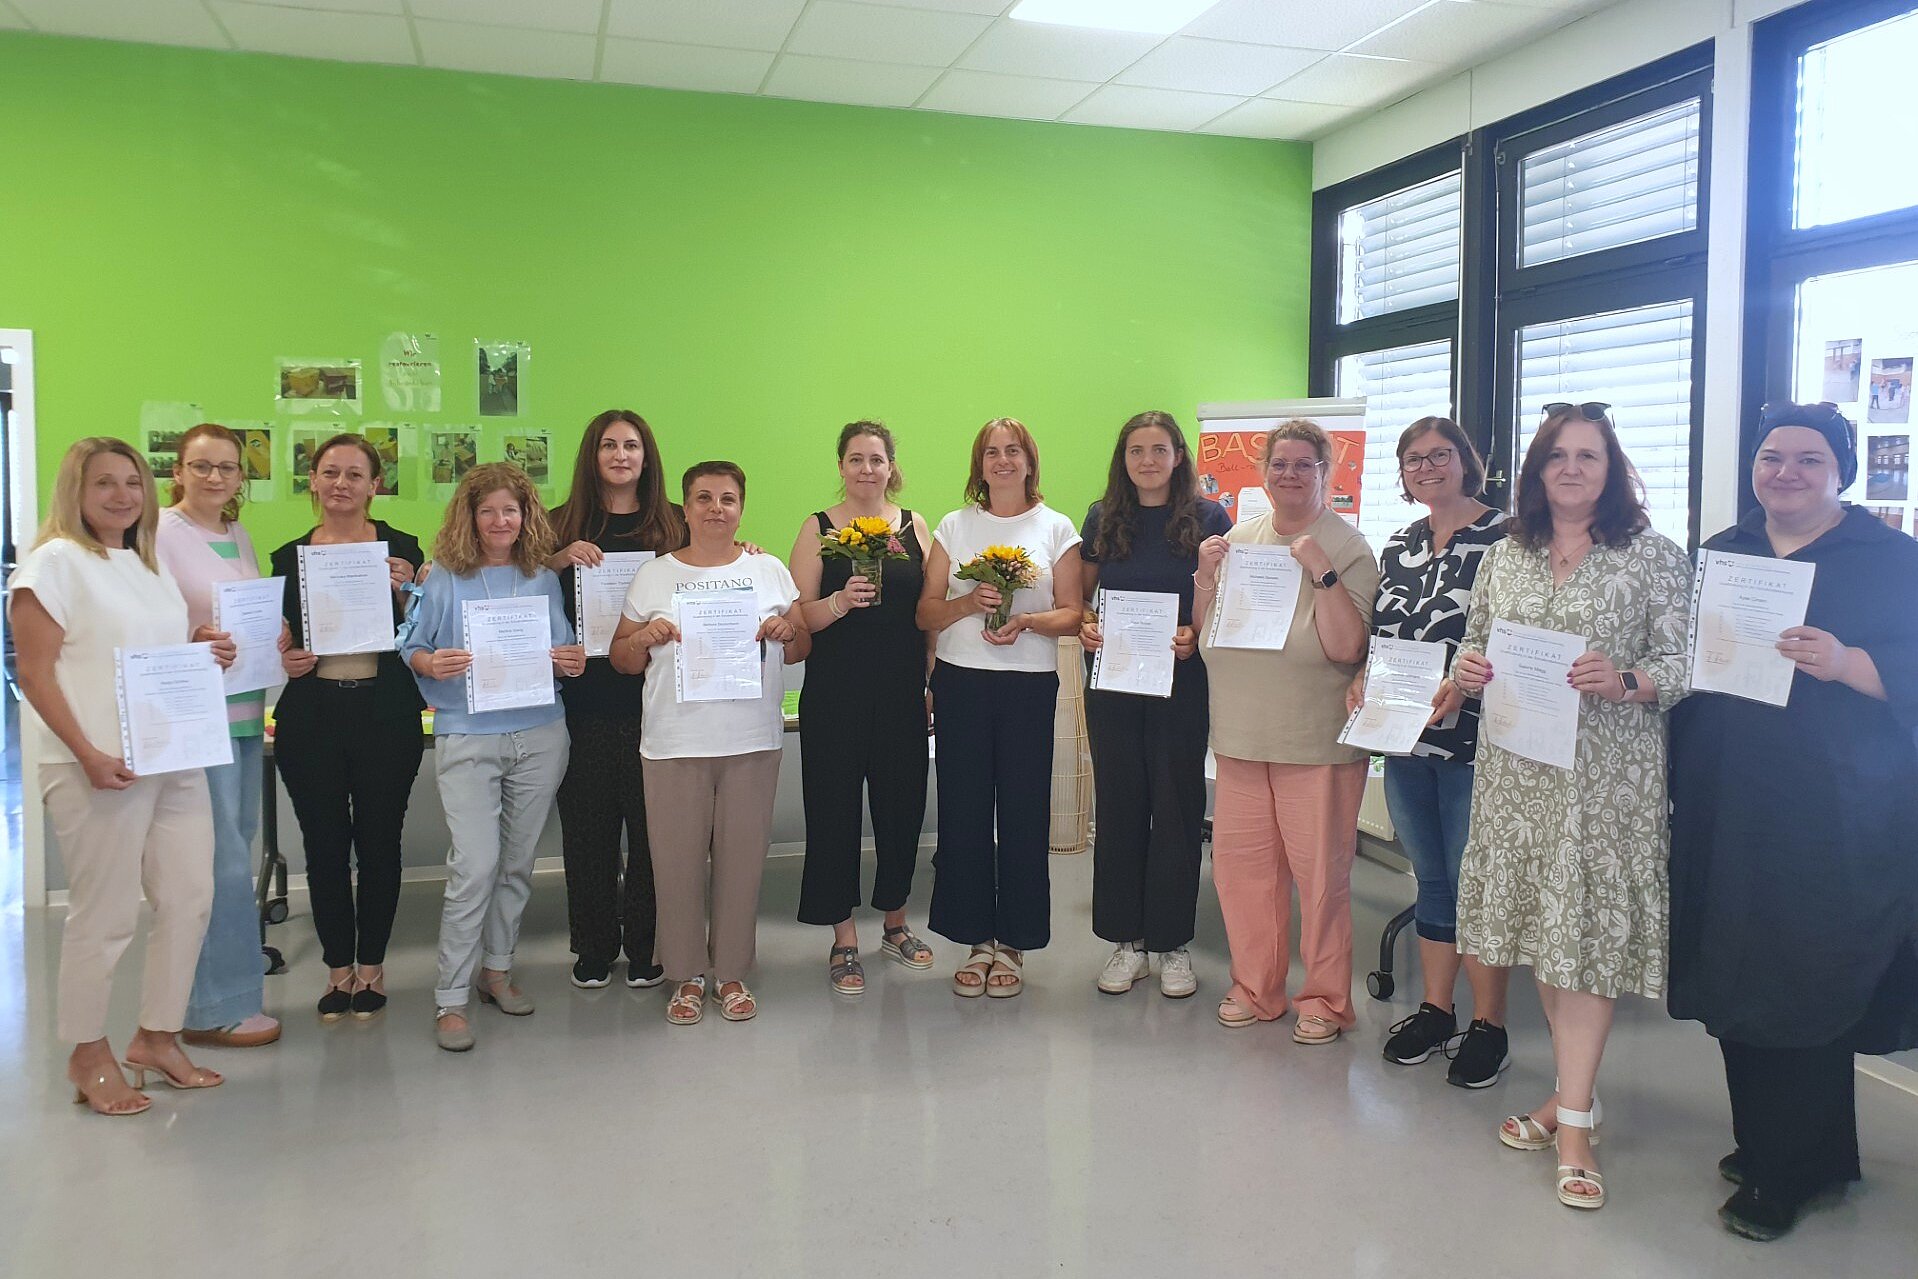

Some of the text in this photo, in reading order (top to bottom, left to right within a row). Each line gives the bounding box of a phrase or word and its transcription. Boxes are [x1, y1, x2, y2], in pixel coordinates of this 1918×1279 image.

[676, 577, 753, 592] POSITANO
[1727, 575, 1787, 589] ZERTIFIKAT
[487, 613, 533, 622] ZERTIFIKAT
[1507, 644, 1561, 660] ZERTIFIKAT
[1388, 656, 1429, 667] ZERTIFIKAT
